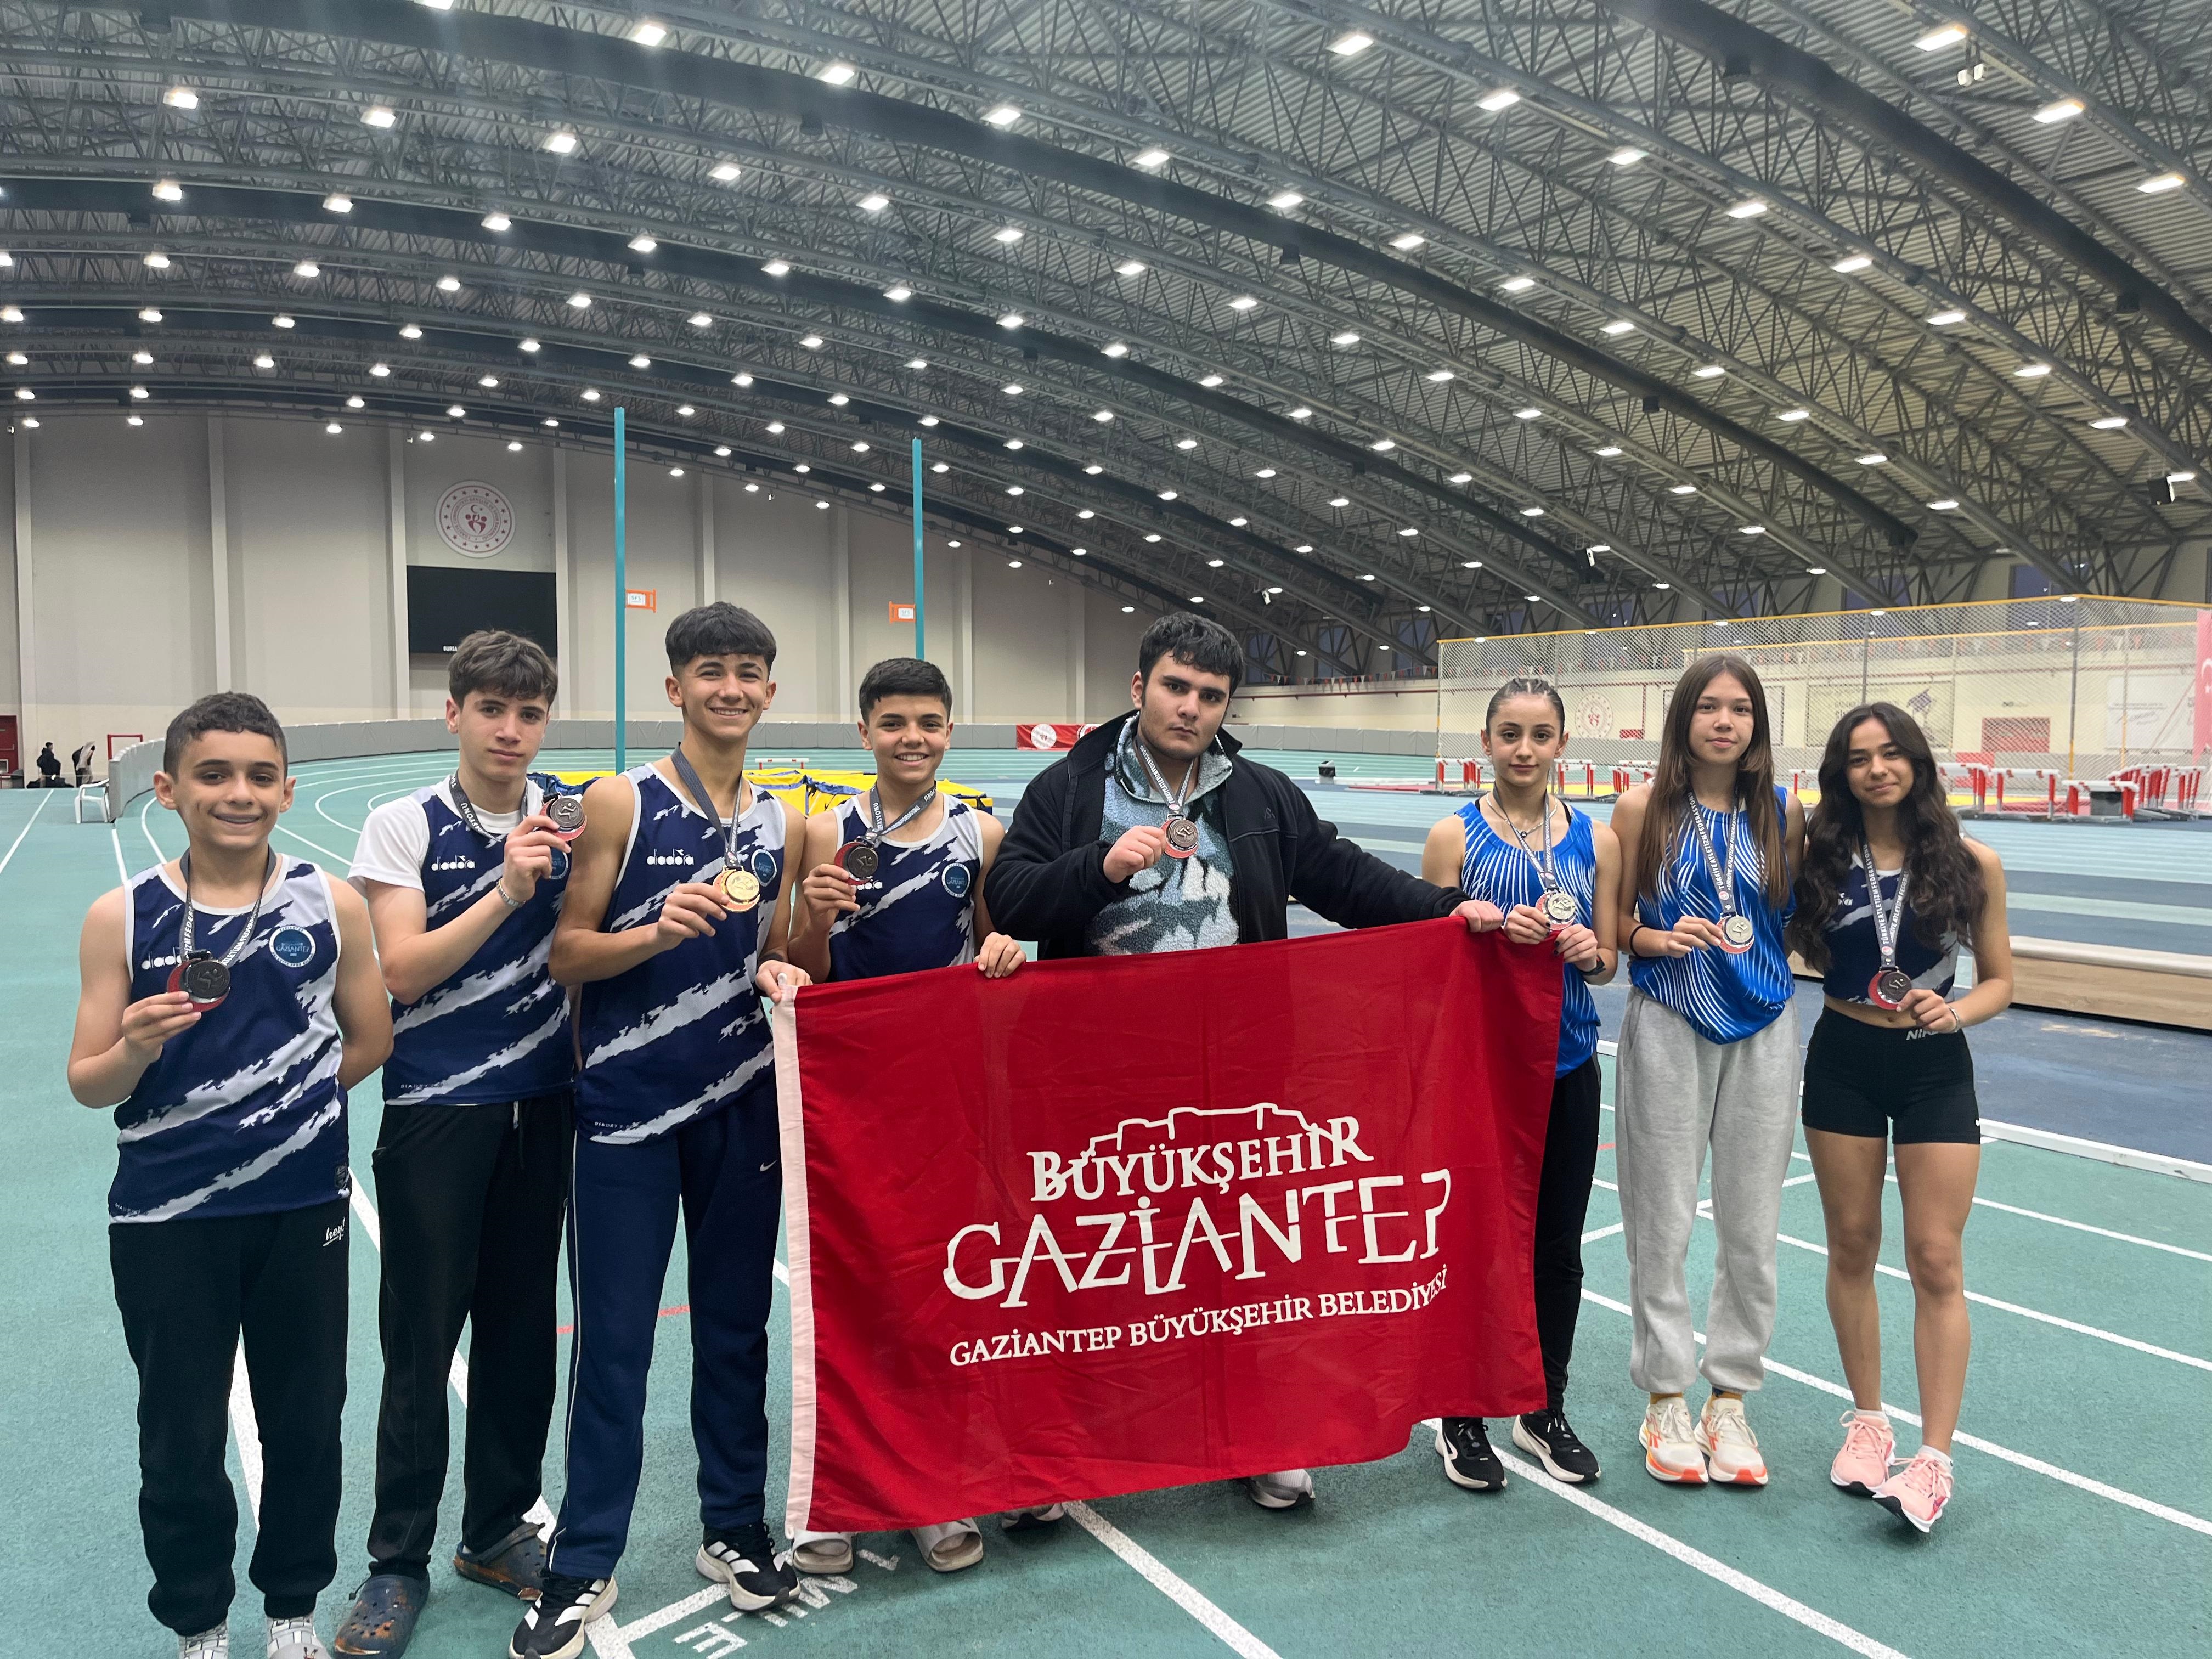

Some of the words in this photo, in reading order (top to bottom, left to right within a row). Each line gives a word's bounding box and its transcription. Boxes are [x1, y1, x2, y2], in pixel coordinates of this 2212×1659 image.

[431, 856, 475, 871] diadora
[647, 849, 694, 865] diadora
[1026, 1115, 1374, 1203] BÜYÜKŞEHİR
[325, 1216, 346, 1241] hey!
[950, 1325, 1122, 1367] GAZİANTEP
[1129, 1294, 1313, 1347] BÜYÜKŞEHİR
[1317, 1263, 1447, 1317] BELEDİYESİ
